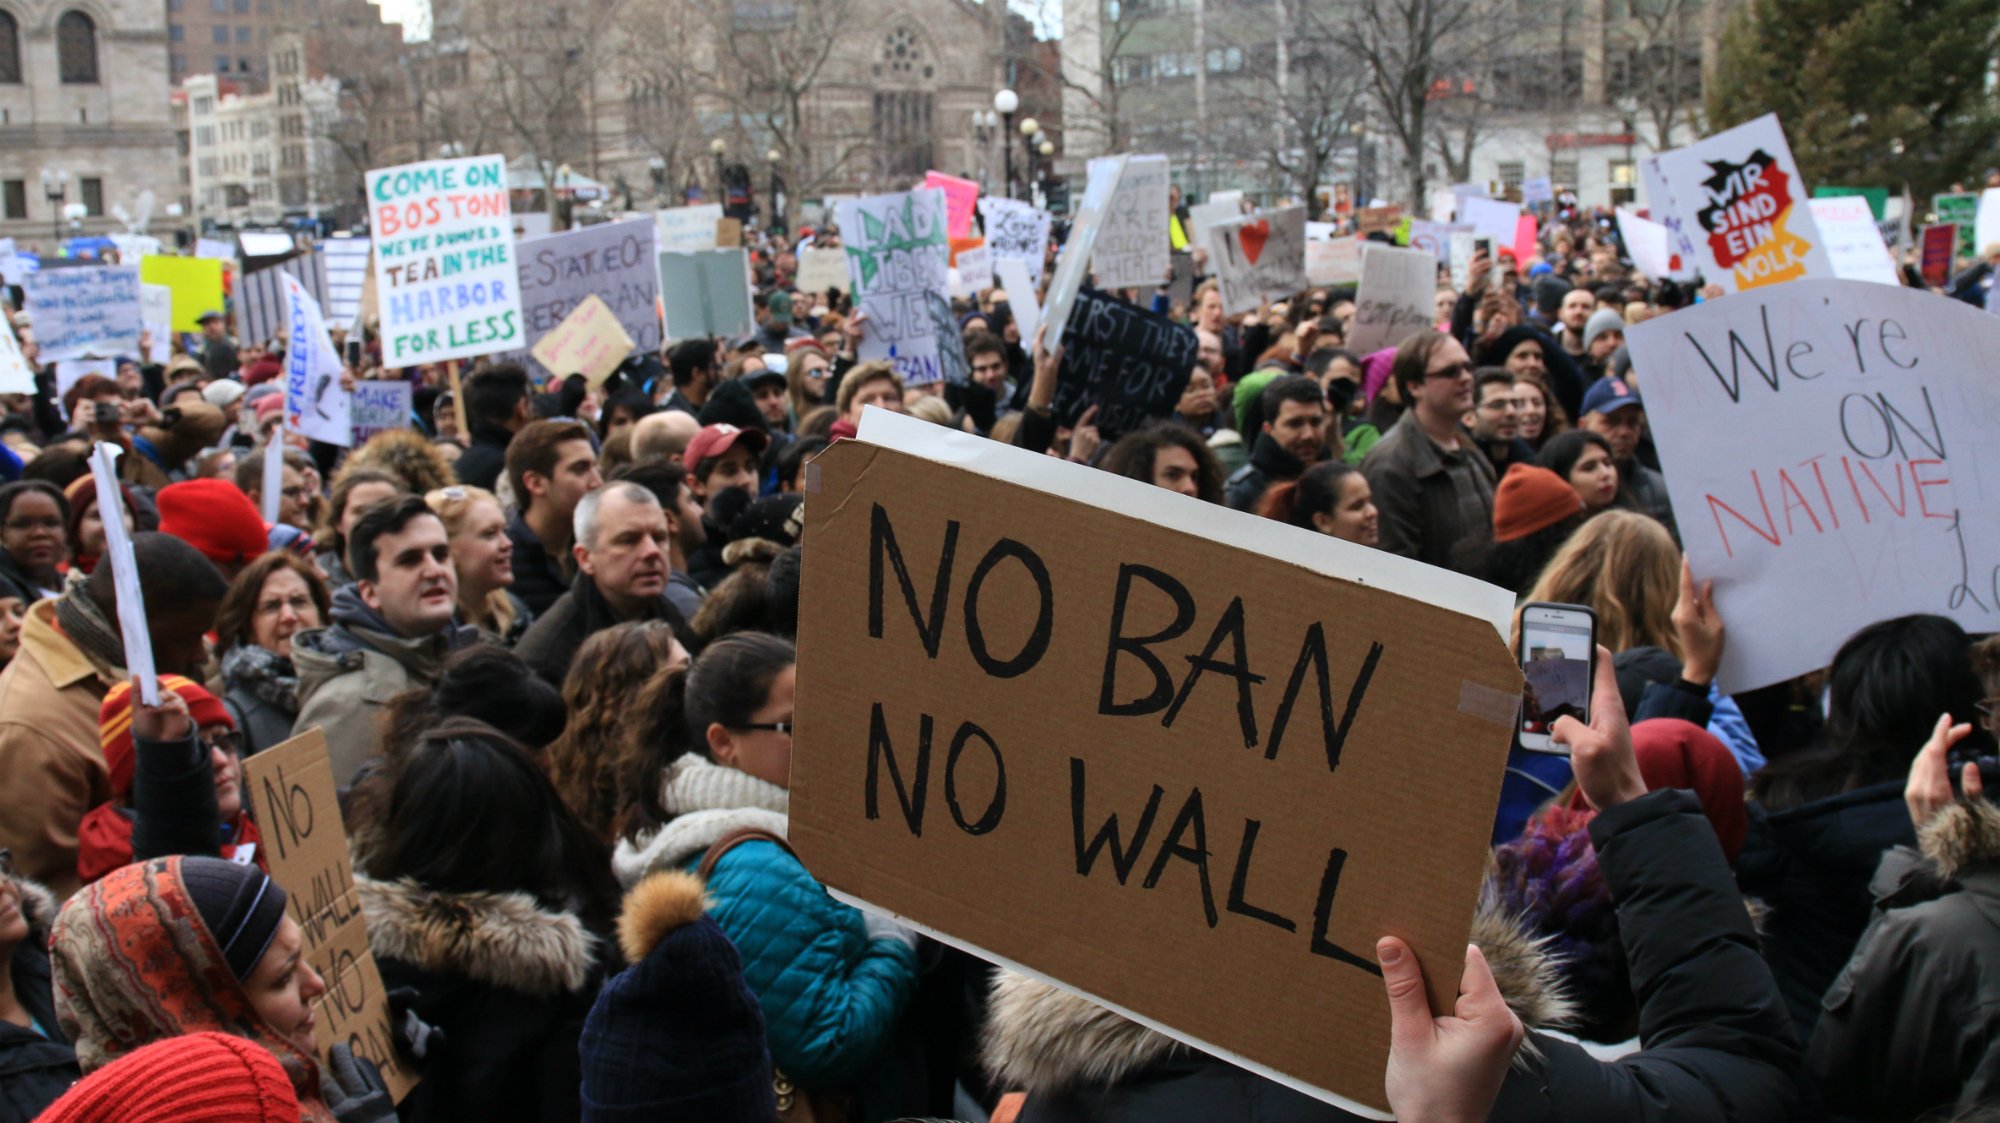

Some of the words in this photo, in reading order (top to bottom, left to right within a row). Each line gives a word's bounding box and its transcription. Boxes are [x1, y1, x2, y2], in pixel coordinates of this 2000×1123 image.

[374, 167, 459, 202] COME
[1701, 163, 1770, 208] WIR
[376, 191, 510, 237] BOSTON!
[1710, 193, 1778, 235] SIND
[1725, 220, 1776, 256] EIN
[378, 230, 429, 257] WE'VE
[434, 225, 501, 249] DUMPED
[1733, 240, 1805, 283] VOLK
[385, 261, 441, 288] TEA
[442, 254, 463, 277] IN
[464, 244, 508, 271] THE
[389, 280, 507, 326] HARBOR
[393, 326, 437, 358] FOR
[448, 310, 516, 349] LESS
[1066, 292, 1139, 343] IRST
[1139, 317, 1198, 368] THEY
[1684, 296, 1919, 403] We're
[1116, 355, 1174, 403] FOR
[1840, 386, 1946, 460] ON
[1705, 454, 1955, 559] NATIVE
[868, 501, 1054, 679] NO
[1098, 561, 1384, 773] BAN
[865, 702, 1007, 839] NO
[1069, 756, 1384, 977] WALL
[291, 861, 361, 950] WALL
[315, 947, 365, 1035] NO
